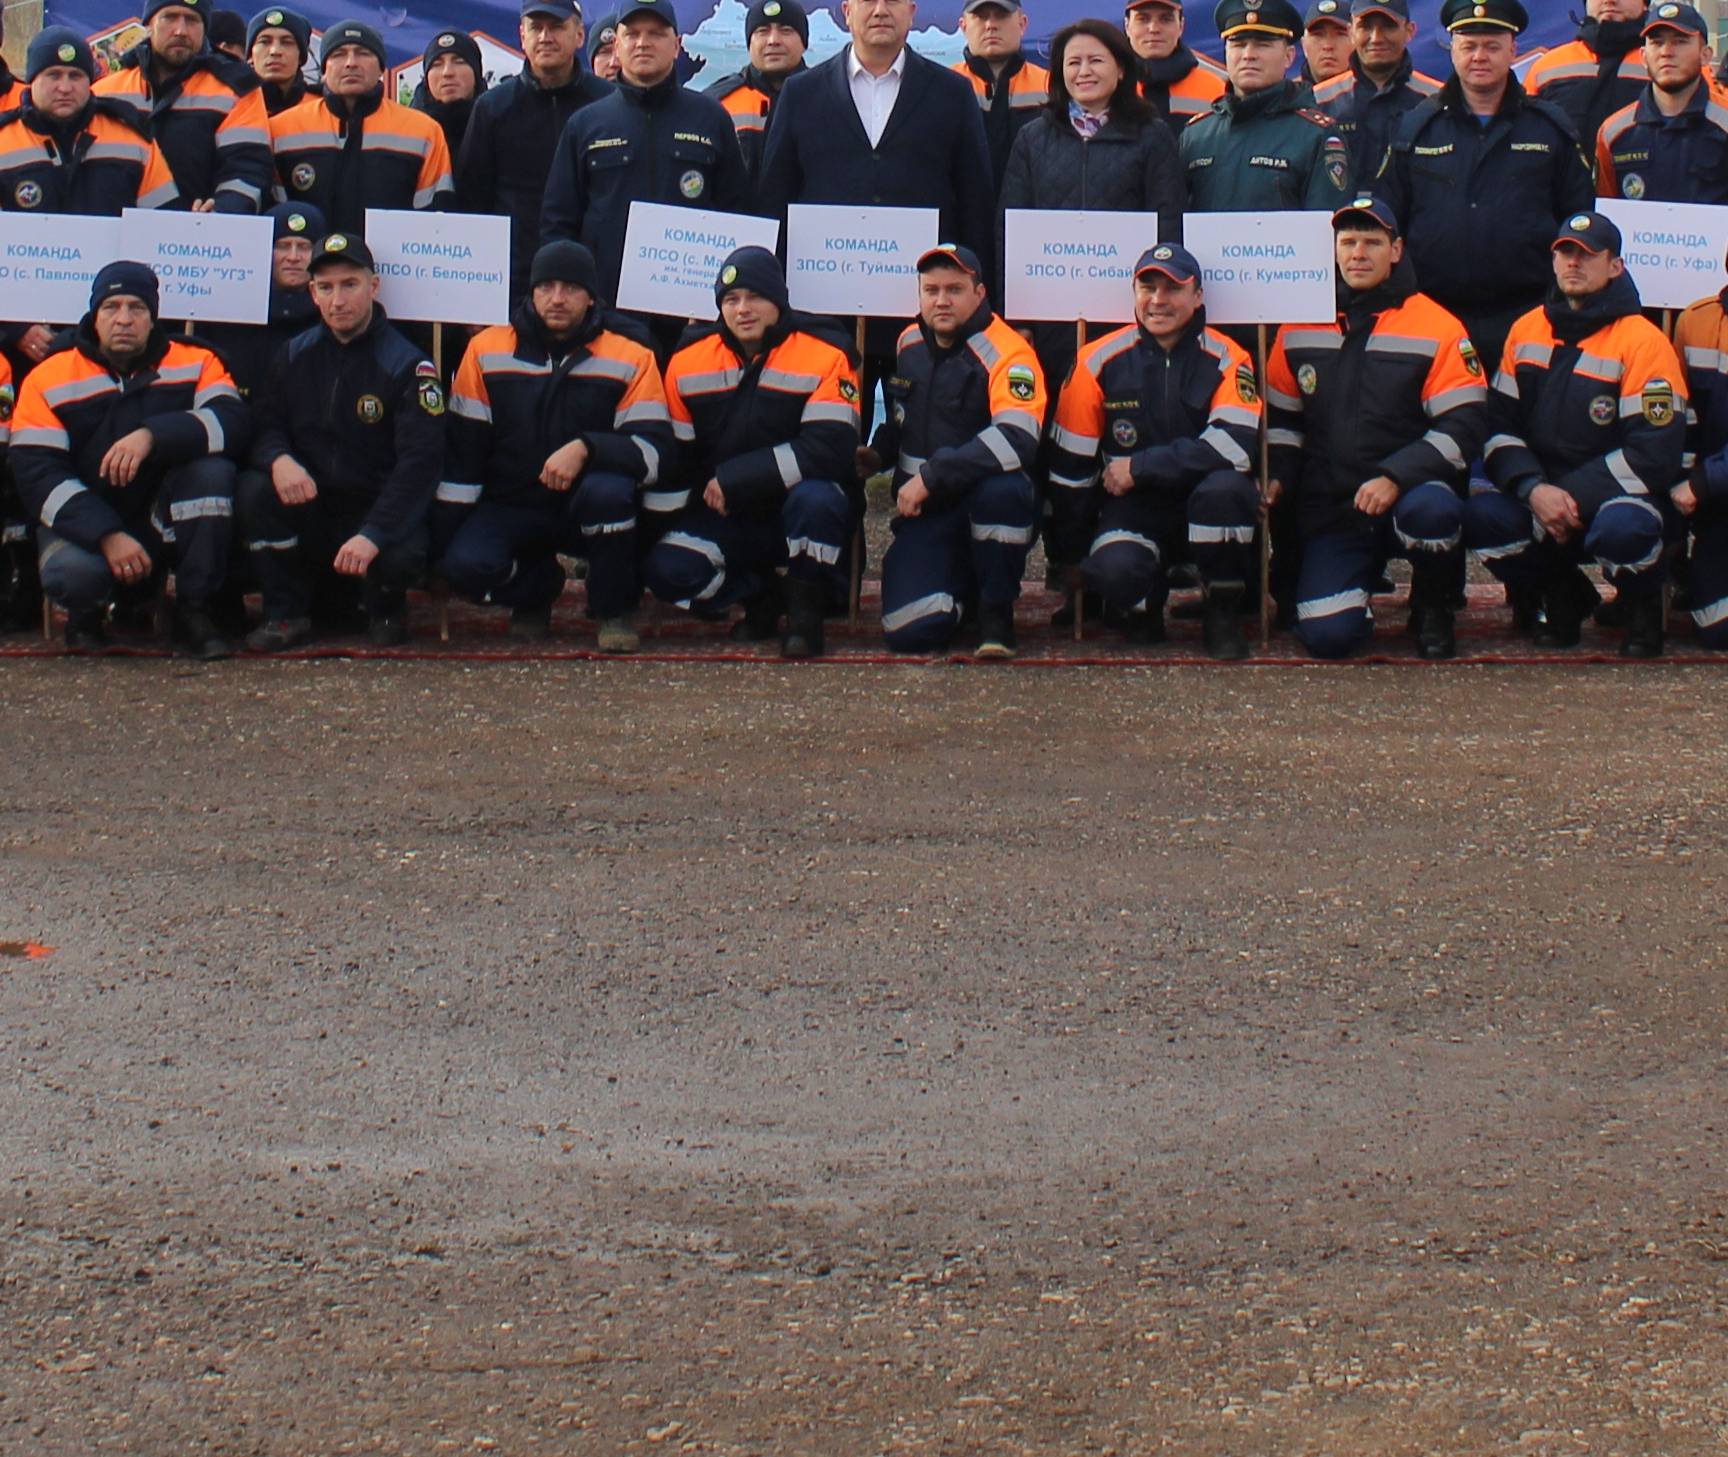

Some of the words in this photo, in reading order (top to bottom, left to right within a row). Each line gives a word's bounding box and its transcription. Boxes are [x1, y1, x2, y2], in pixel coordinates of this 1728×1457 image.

[664, 228, 737, 249] КОМАНДА
[825, 238, 899, 253] КОМАНДА
[1633, 231, 1708, 248] КОМАНДА
[7, 244, 82, 261] КОМАНДА
[158, 242, 233, 259] КОМАНДА
[401, 242, 472, 259] КОМАНДА
[639, 246, 679, 262] ЗПСО
[1043, 243, 1118, 258] КОМАНДА
[1222, 245, 1296, 259] КОМАНДА
[177, 264, 209, 279] МБУ
[796, 258, 837, 272] ЗПСО
[1025, 264, 1066, 276] ЗПСО
[1088, 265, 1133, 278] Сибай
[1683, 257, 1718, 272] Уфа)
[432, 266, 503, 285] Белорецк)
[1203, 269, 1235, 281] ПСО
[1256, 268, 1329, 283] Кумертау)
[164, 284, 174, 294] г.
[177, 281, 212, 297] Уфы
